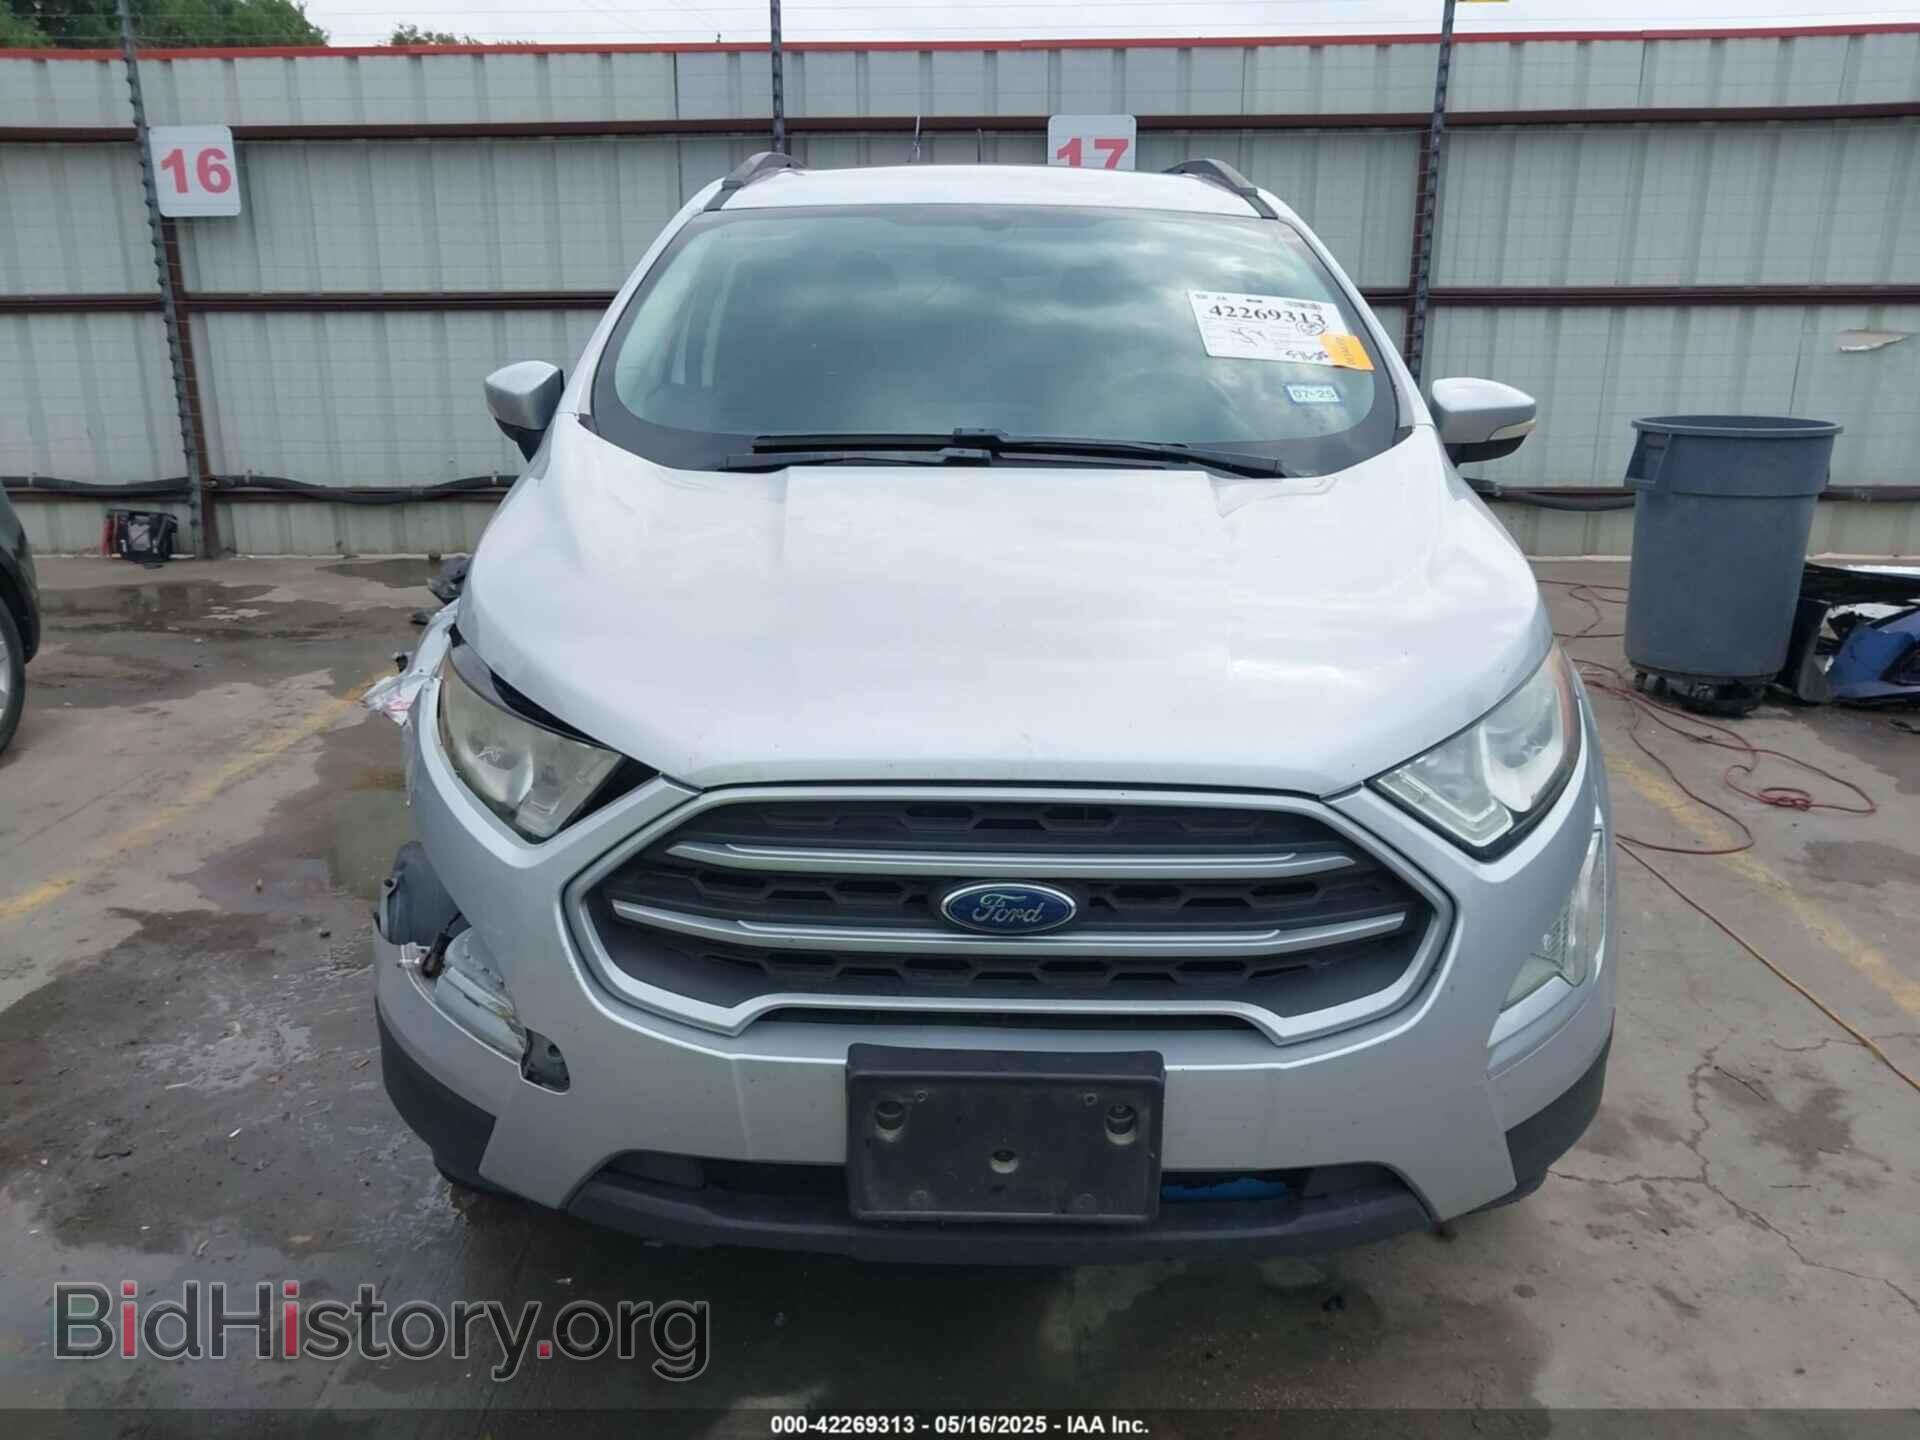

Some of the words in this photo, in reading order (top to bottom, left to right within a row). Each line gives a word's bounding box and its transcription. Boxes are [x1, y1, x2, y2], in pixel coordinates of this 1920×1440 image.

[1056, 138, 1129, 169] 17
[161, 148, 231, 193] 16
[1209, 304, 1326, 326] 42269313
[972, 893, 1045, 922] Ford
